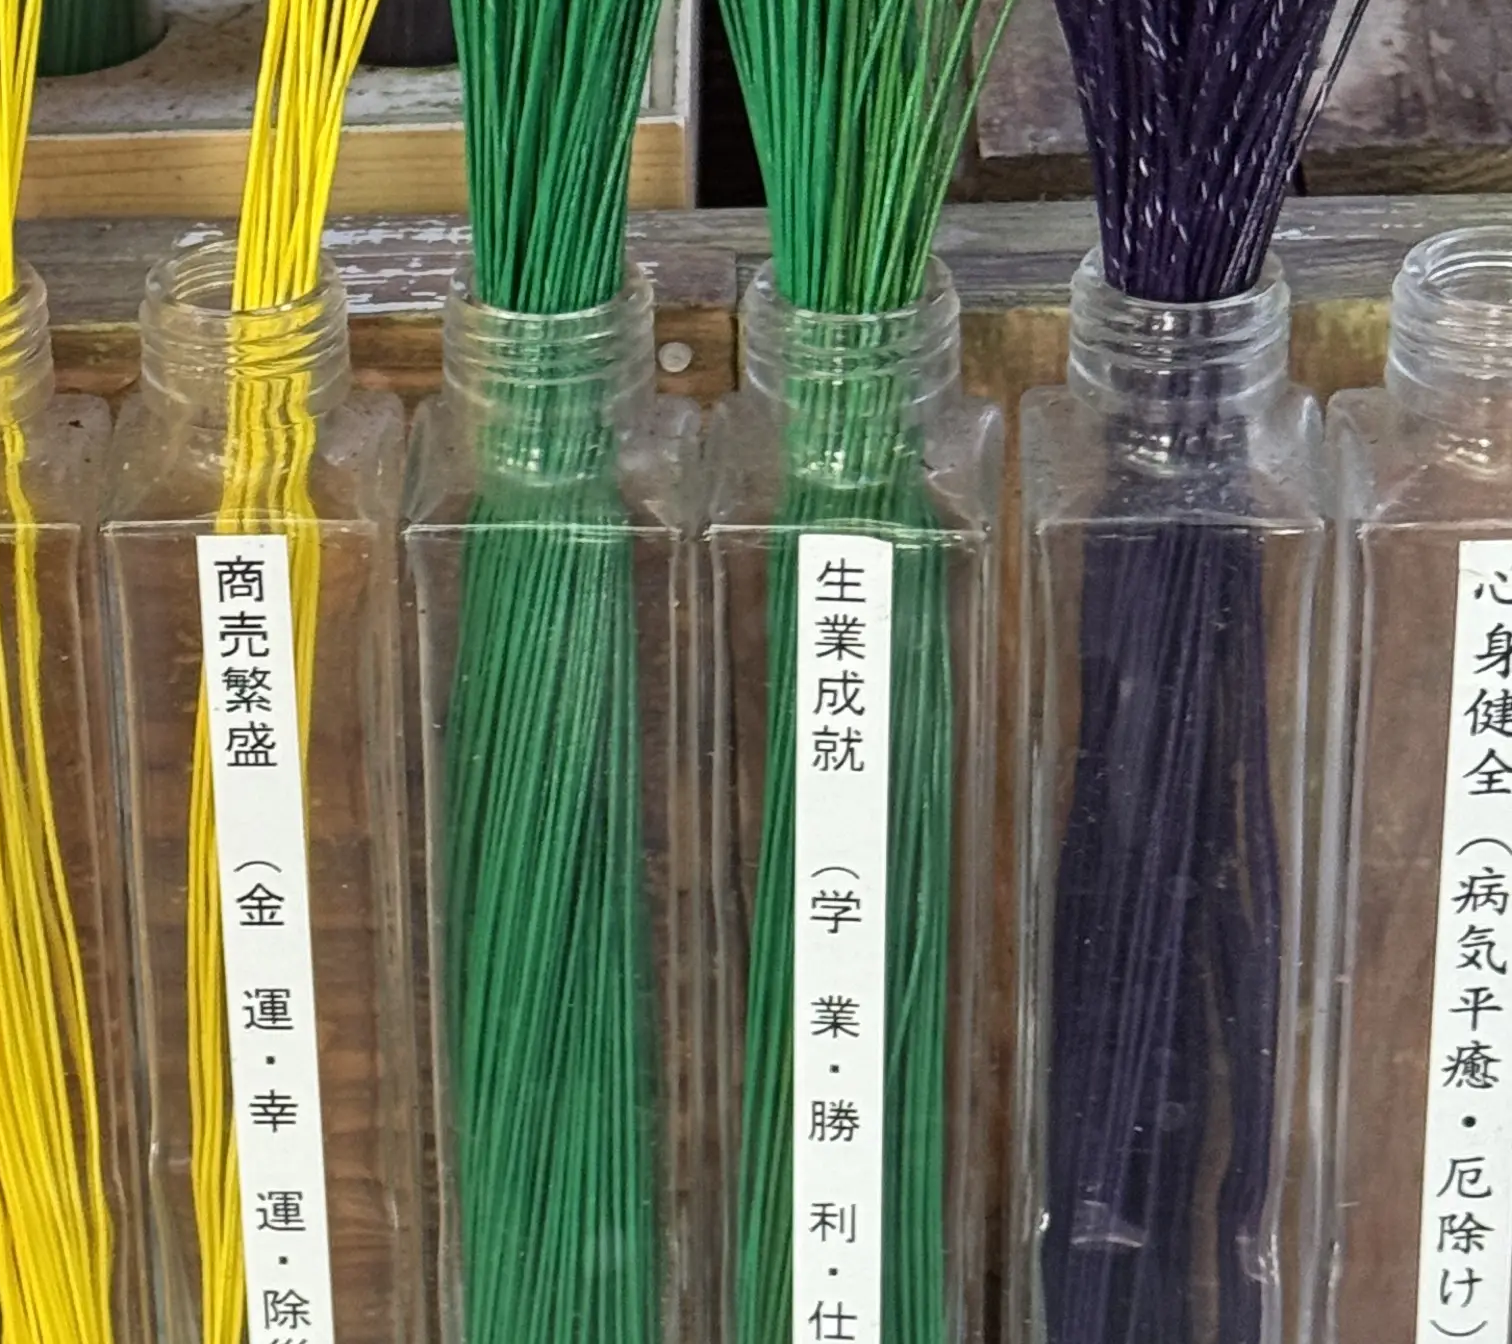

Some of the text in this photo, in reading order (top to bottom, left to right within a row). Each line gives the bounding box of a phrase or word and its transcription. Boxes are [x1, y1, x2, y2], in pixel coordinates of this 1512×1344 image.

[213, 554, 278, 767] 商売繁盛
[812, 557, 866, 772] 生業成就
